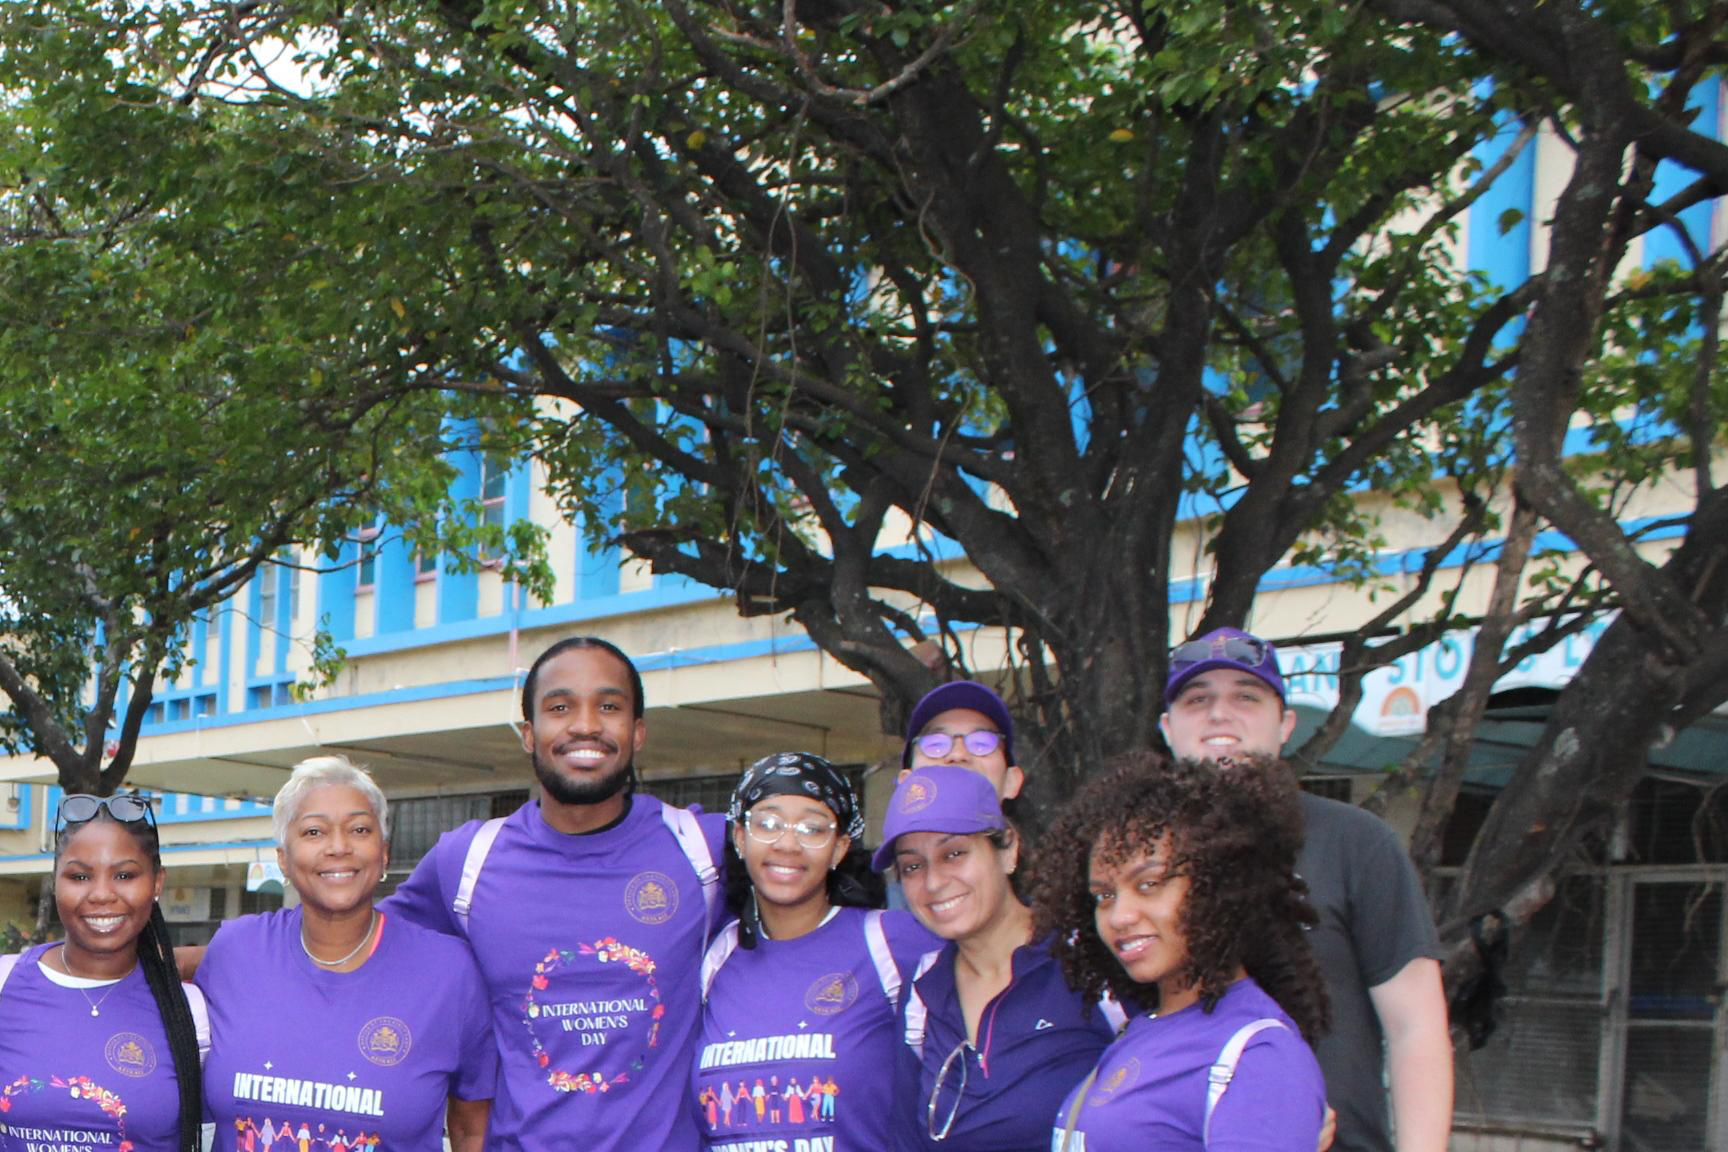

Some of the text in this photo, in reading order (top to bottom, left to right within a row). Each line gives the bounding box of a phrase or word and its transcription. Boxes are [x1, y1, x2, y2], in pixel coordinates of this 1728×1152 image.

[542, 999, 648, 1017] INTERNATIONAL
[562, 1015, 628, 1031] WOMEN'S
[581, 1032, 608, 1046] DAY
[233, 1072, 384, 1116] INTERNATIONAL
[8, 1125, 112, 1144] INTERNATIONAL
